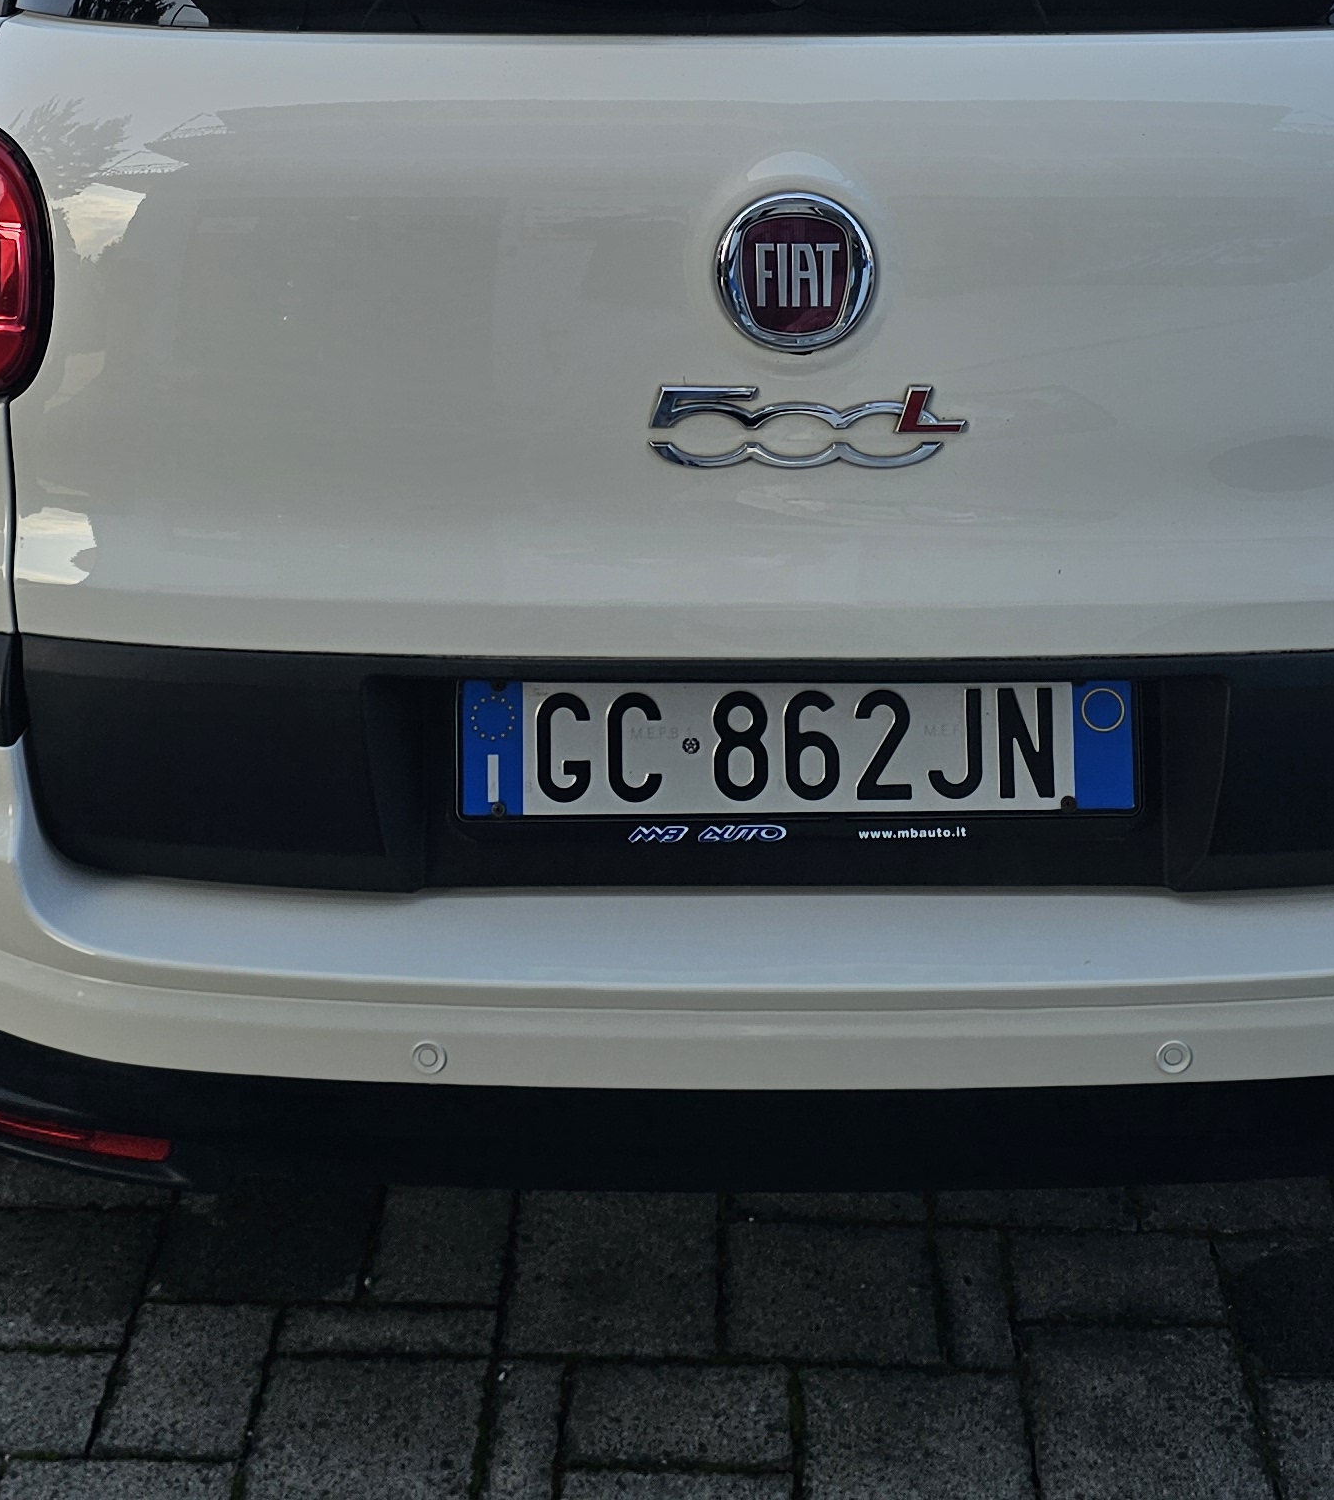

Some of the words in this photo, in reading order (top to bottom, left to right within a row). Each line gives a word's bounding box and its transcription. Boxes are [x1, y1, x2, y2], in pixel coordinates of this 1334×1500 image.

[755, 242, 840, 307] FIAT
[648, 384, 967, 469] 500L
[535, 691, 663, 803] GC
[711, 687, 1056, 802] 862JN
[697, 824, 787, 843] AUTO
[858, 826, 967, 840] www.mbauto.it
